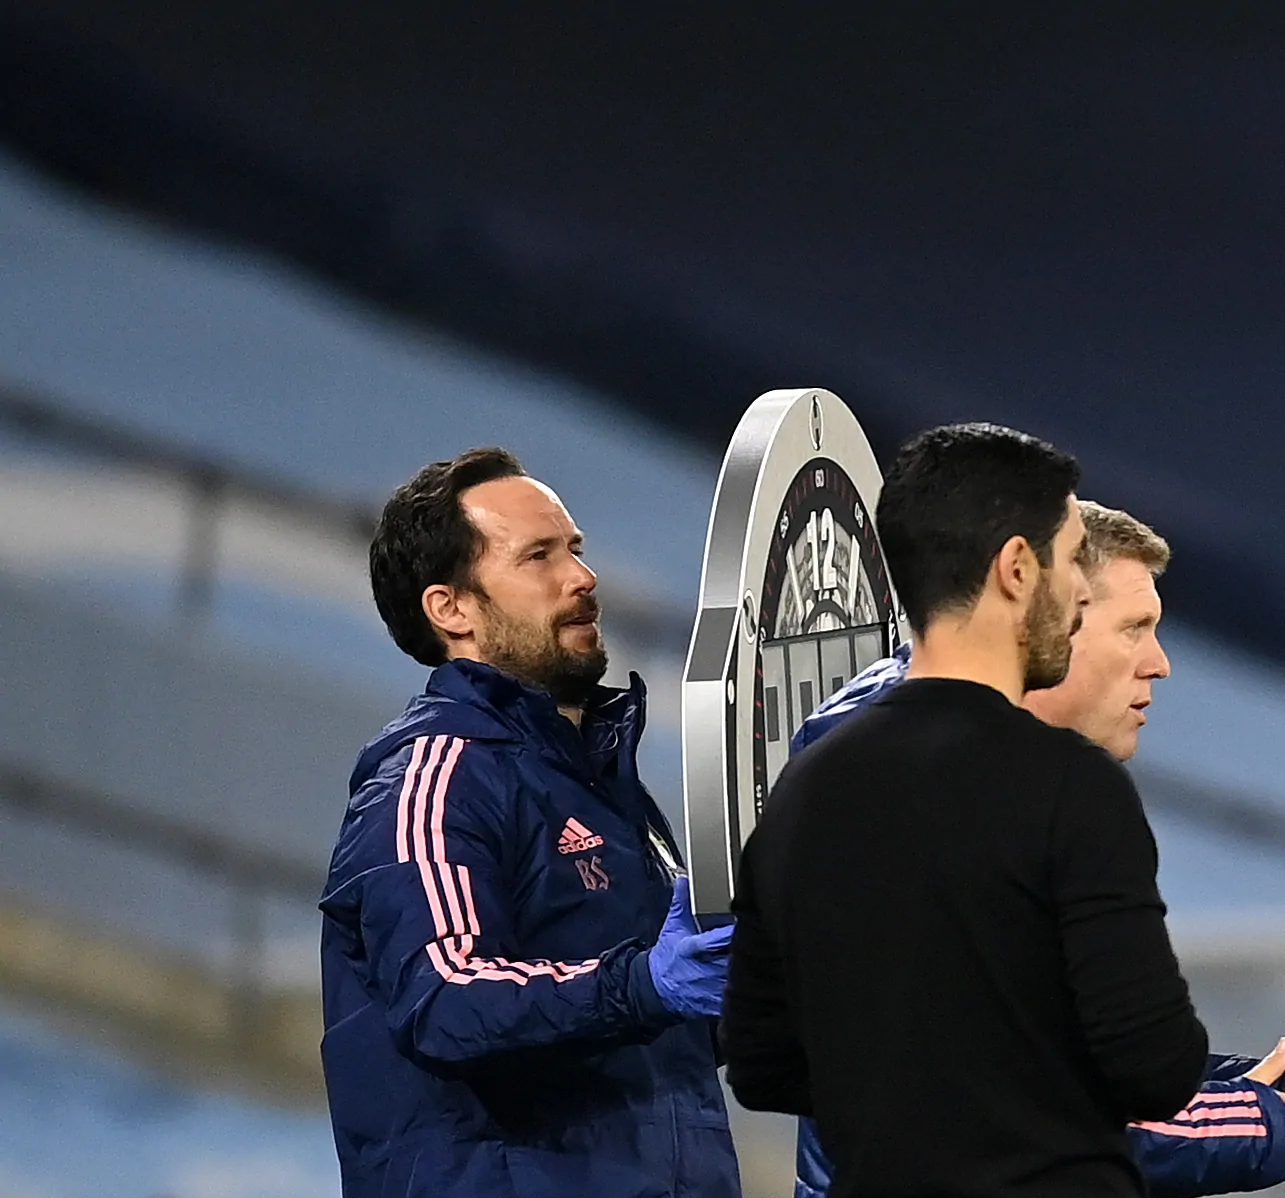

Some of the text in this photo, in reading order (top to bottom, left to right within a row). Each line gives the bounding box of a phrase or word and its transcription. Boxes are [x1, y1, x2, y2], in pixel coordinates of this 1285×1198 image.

[806, 507, 838, 591] 12
[558, 835, 604, 855] adidas
[574, 855, 610, 891] BS
